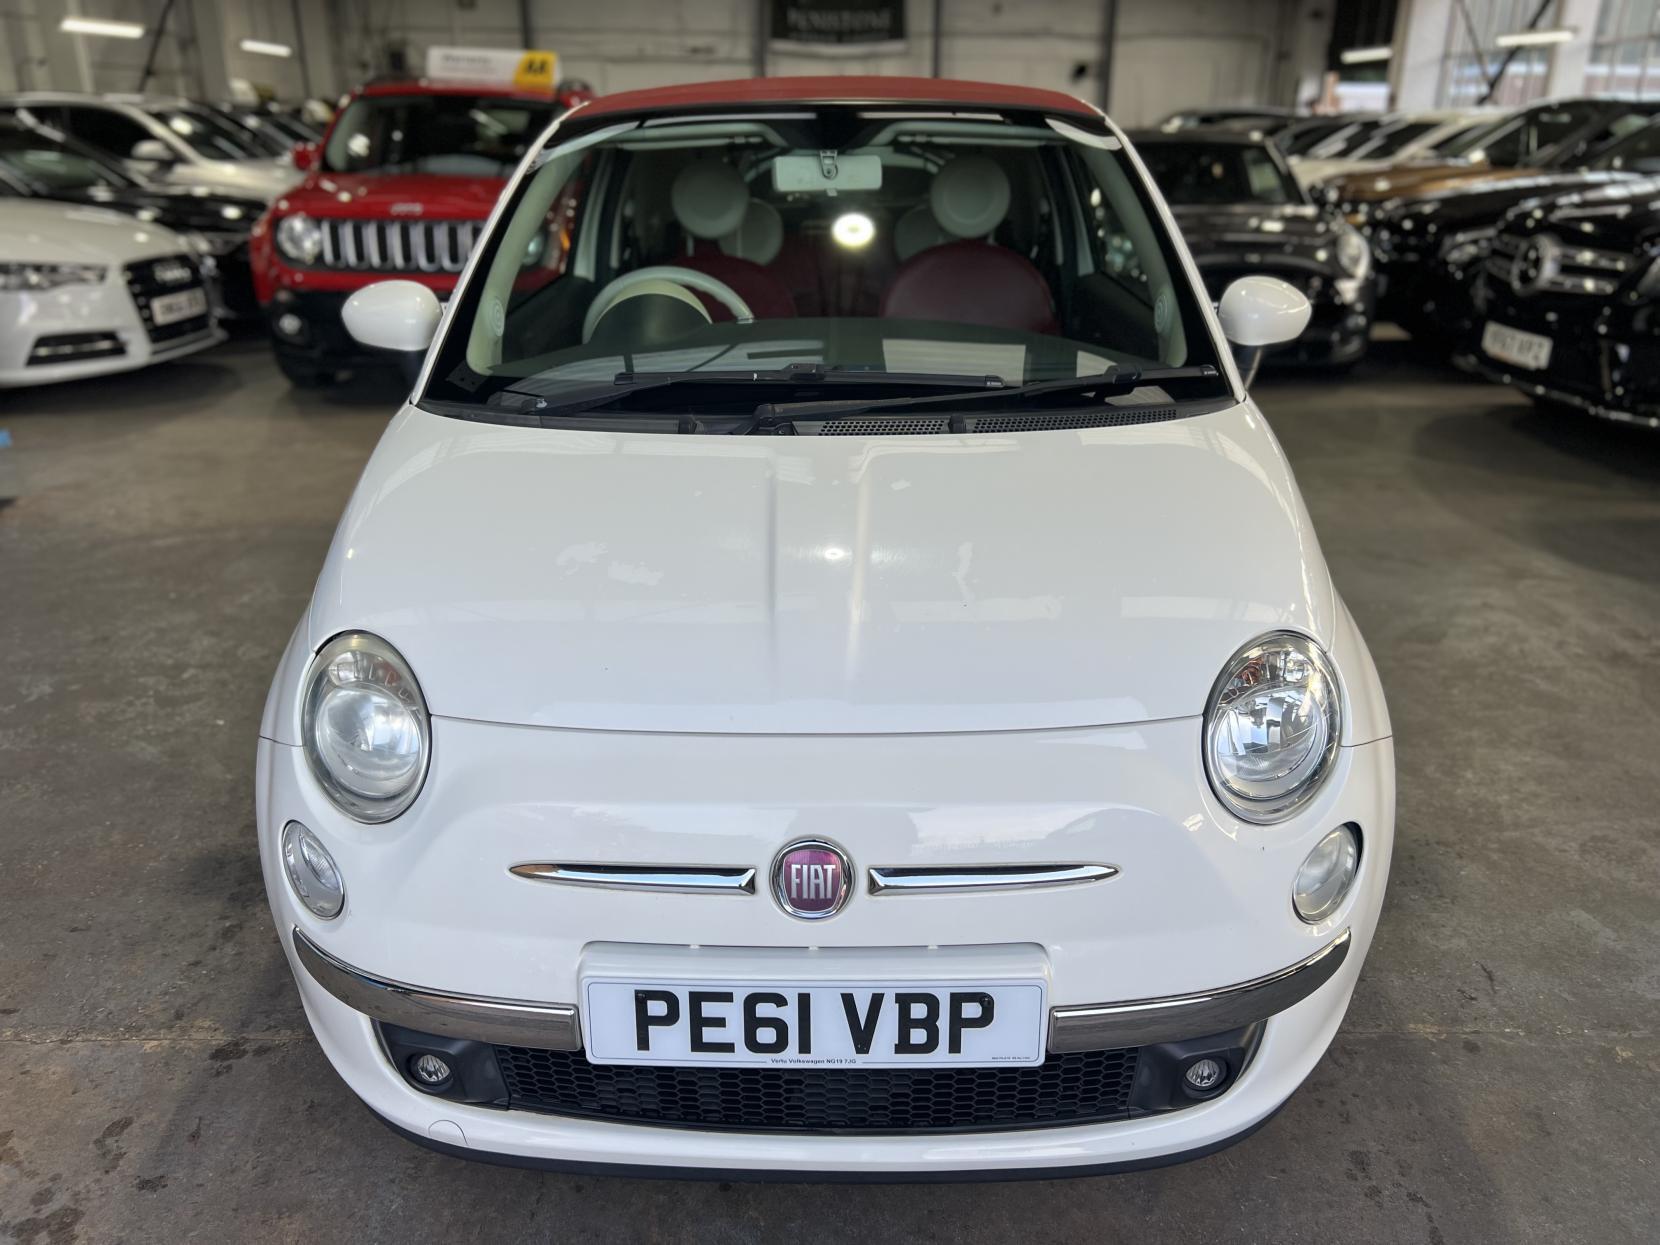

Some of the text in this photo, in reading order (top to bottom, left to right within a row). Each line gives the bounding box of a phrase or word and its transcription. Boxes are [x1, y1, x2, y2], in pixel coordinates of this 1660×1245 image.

[790, 864, 836, 900] FIAT
[634, 989, 995, 1054] PE61 VBP
